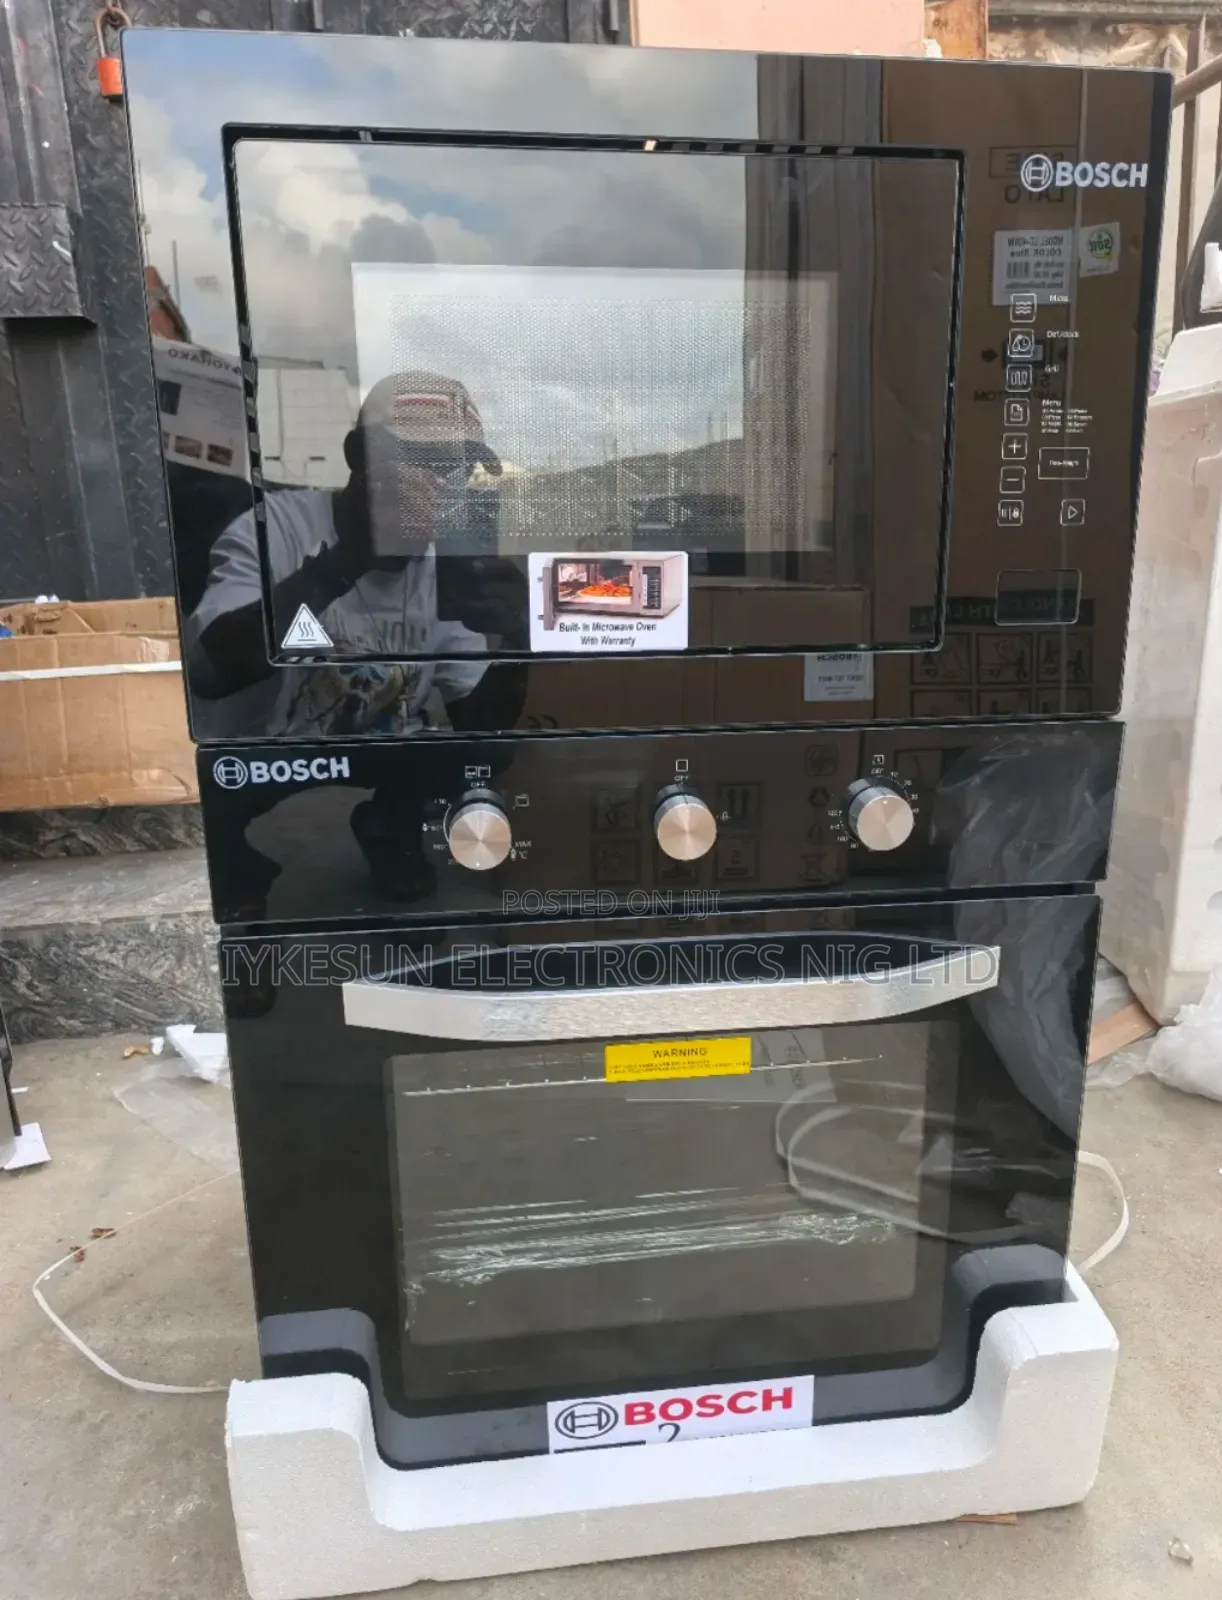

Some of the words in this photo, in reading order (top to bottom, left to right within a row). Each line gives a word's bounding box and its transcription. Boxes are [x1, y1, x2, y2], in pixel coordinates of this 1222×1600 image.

[1055, 161, 1148, 188] BOSCH
[592, 621, 634, 632] Microwave
[636, 621, 657, 632] Oven
[580, 635, 599, 646] With
[600, 635, 636, 648] Warranty
[250, 756, 350, 784] BOSCH
[652, 1047, 708, 1059] WARNING
[624, 1387, 793, 1426] BOSCH
